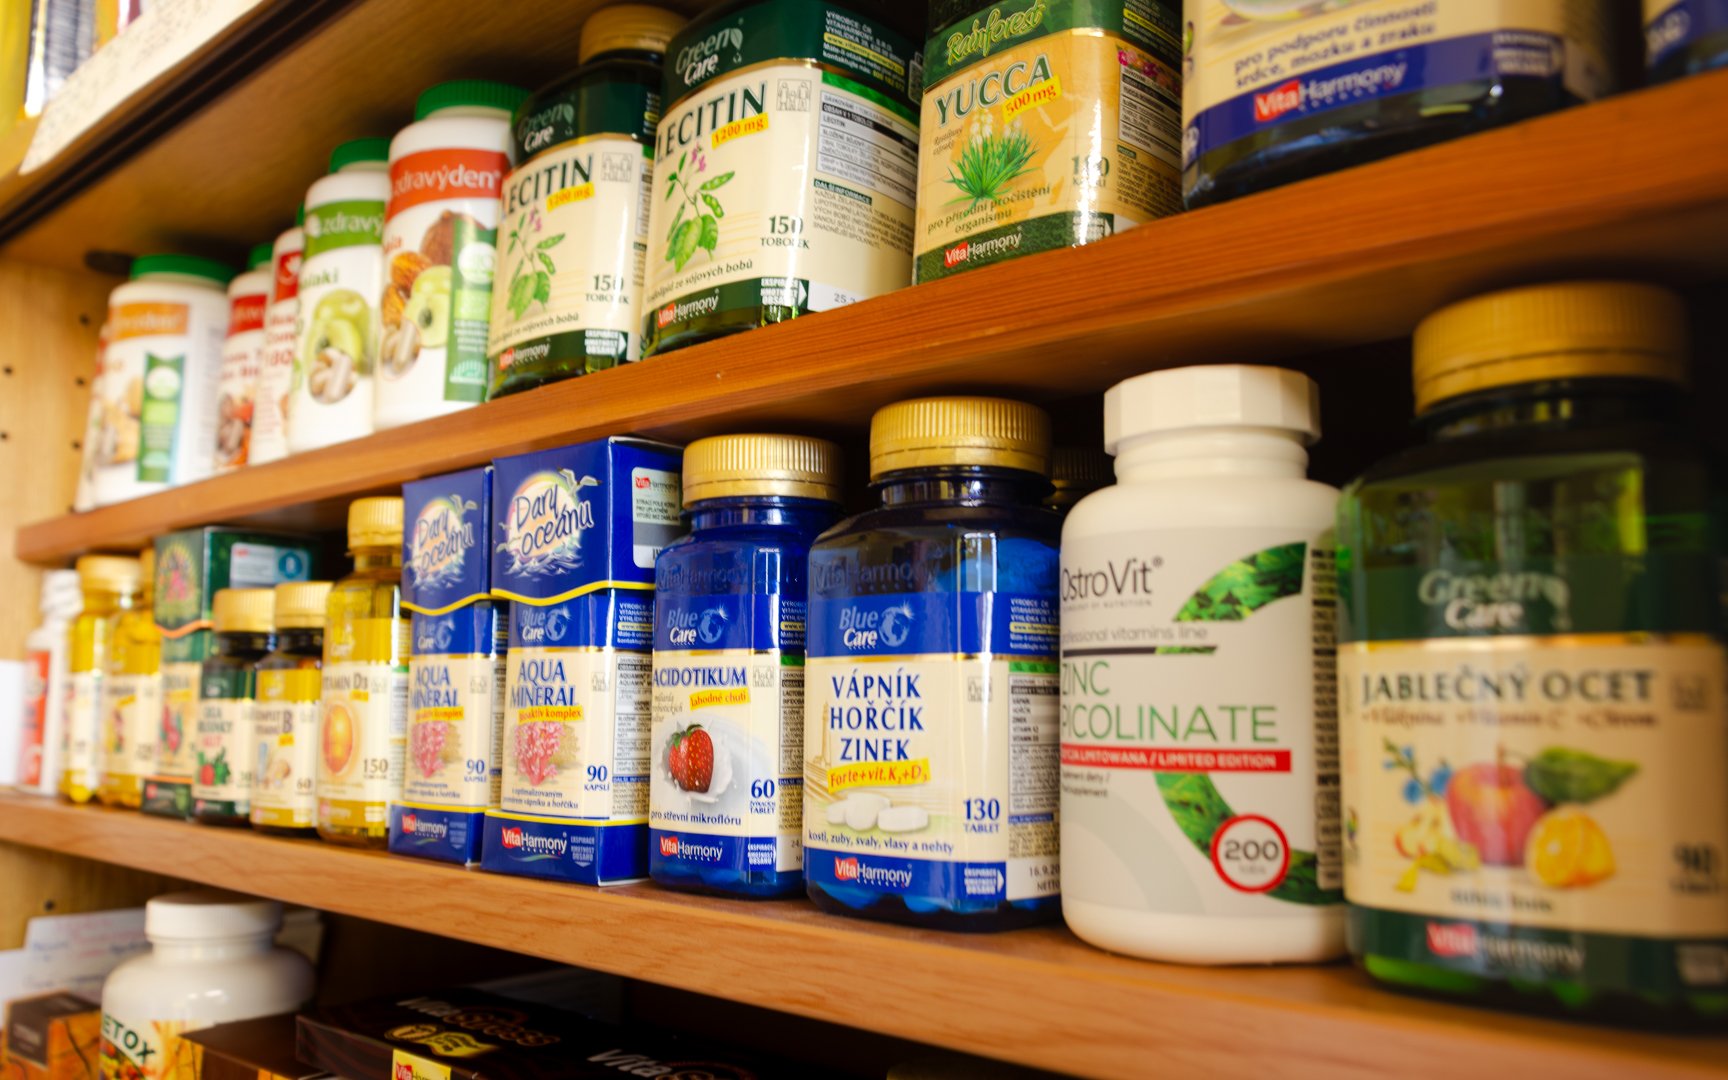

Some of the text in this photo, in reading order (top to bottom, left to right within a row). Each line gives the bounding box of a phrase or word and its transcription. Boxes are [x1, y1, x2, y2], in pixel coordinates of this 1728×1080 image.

[946, 0, 1046, 65] Rainforest
[1290, 40, 1355, 67] mozku
[1361, 37, 1371, 48] a
[1379, 24, 1434, 44] zraku
[676, 27, 731, 74] Green
[1234, 52, 1263, 75] pro
[1267, 27, 1347, 60] podporu
[684, 54, 719, 87] Care
[934, 53, 1054, 128] YUCCA
[1005, 83, 1058, 117] 500 mg
[1256, 62, 1407, 117] VitaHarmony
[656, 81, 767, 164] LECITIN
[712, 118, 765, 146] 1200 mg
[525, 126, 554, 152] Care
[768, 216, 804, 235] 150
[927, 218, 944, 234] pro
[945, 201, 988, 228] přírodní
[954, 209, 1012, 233] organismu
[945, 230, 1023, 267] VitaHarmony
[594, 275, 624, 291] 150
[684, 266, 724, 286] sójových
[725, 257, 753, 273] bobů
[658, 294, 719, 327] VitaHarmony
[512, 484, 558, 533] Dary
[417, 509, 450, 548] Dary
[520, 502, 595, 556] oceánu
[420, 523, 475, 572] oceánu
[1061, 558, 1153, 602] OstroVit
[1418, 569, 1546, 606] Green
[521, 606, 546, 627] Blue
[667, 607, 698, 628] Blue
[839, 605, 878, 630] Blue
[1445, 598, 1524, 630] Care
[522, 625, 546, 642] Care
[669, 627, 697, 645] Care
[843, 628, 878, 649] Care
[1110, 625, 1175, 640] vitamins
[1180, 622, 1208, 638] line
[415, 666, 450, 688] AQUA
[518, 659, 567, 687] AQUA
[653, 666, 747, 687] ACIDOTIKUM
[832, 667, 921, 699] VÁPNÍK
[1061, 660, 1110, 697] ZINC
[1362, 663, 1654, 705] JABLEČNÝ OCET
[510, 686, 580, 708] MINERAL
[691, 694, 723, 708] lahodné
[725, 690, 746, 701] chuti
[545, 708, 581, 721] komplex
[830, 700, 923, 731] HOŘČÍK
[1061, 704, 1279, 743] PICOLINATE
[840, 738, 910, 761] ZINEK
[1159, 752, 1215, 767] LIMITED
[1217, 754, 1277, 768] EDITION
[363, 758, 388, 776] 150
[467, 759, 485, 775] 90
[587, 765, 608, 781] 90
[584, 783, 610, 792] KAPSLÍ
[751, 779, 775, 798] 60
[651, 809, 741, 826] pro střevní mikroflóru
[963, 799, 1000, 822] 130
[502, 828, 567, 855] VitaHarmony
[808, 830, 829, 843] kosti,
[831, 834, 853, 846] zuby,
[856, 837, 882, 848] svaly,
[884, 838, 909, 850] vlasy
[922, 842, 954, 853] nehty
[963, 824, 999, 833] TABLET
[660, 836, 722, 862] VitaHarmony
[1224, 840, 1280, 861] 200
[835, 857, 912, 888] VitaHarmony
[587, 1048, 673, 1078] Vita
